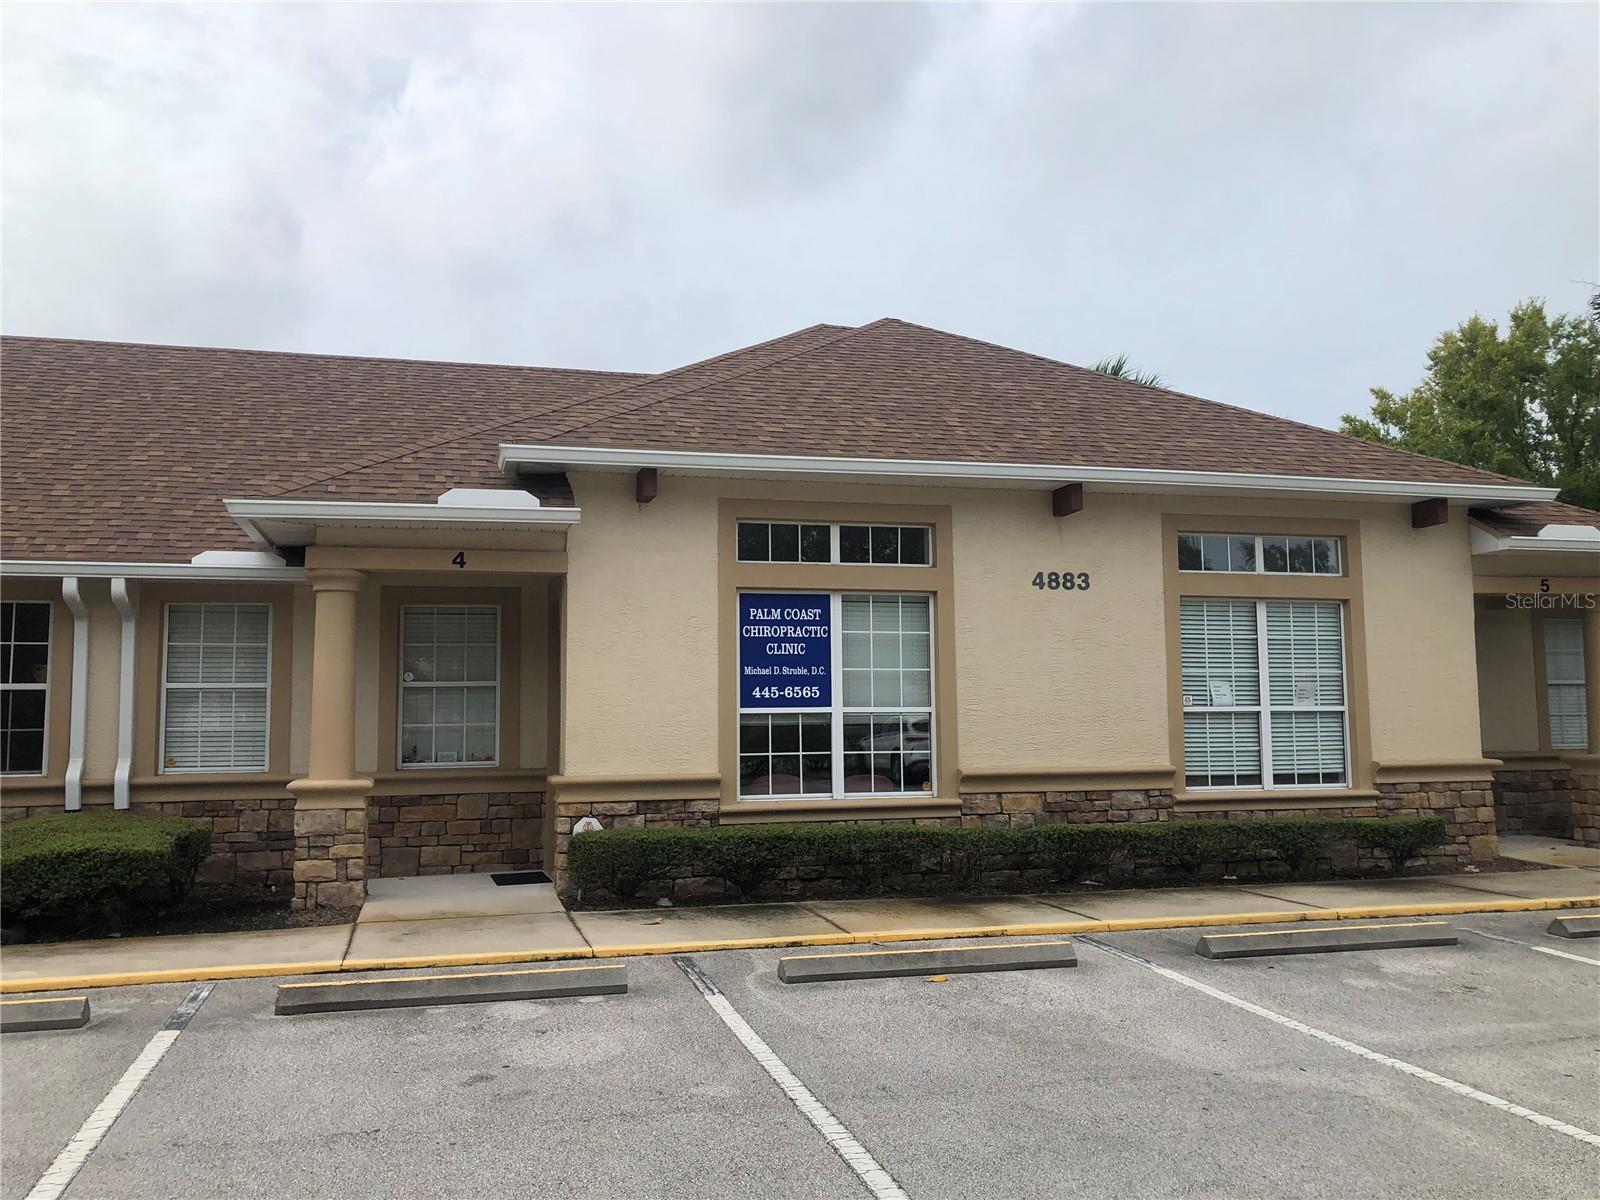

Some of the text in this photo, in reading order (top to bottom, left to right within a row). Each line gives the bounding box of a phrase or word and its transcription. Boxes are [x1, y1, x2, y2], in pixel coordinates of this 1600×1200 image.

[452, 551, 466, 568] 4
[1032, 571, 1090, 591] 4883
[1540, 579, 1550, 592] 5
[749, 608, 821, 620] PALM COAST
[742, 625, 828, 637] CHIROPRACTIC
[766, 643, 806, 655] CLINIC
[744, 666, 826, 676] Michael D. Struble, D.C.
[752, 686, 820, 698] 445-6565
